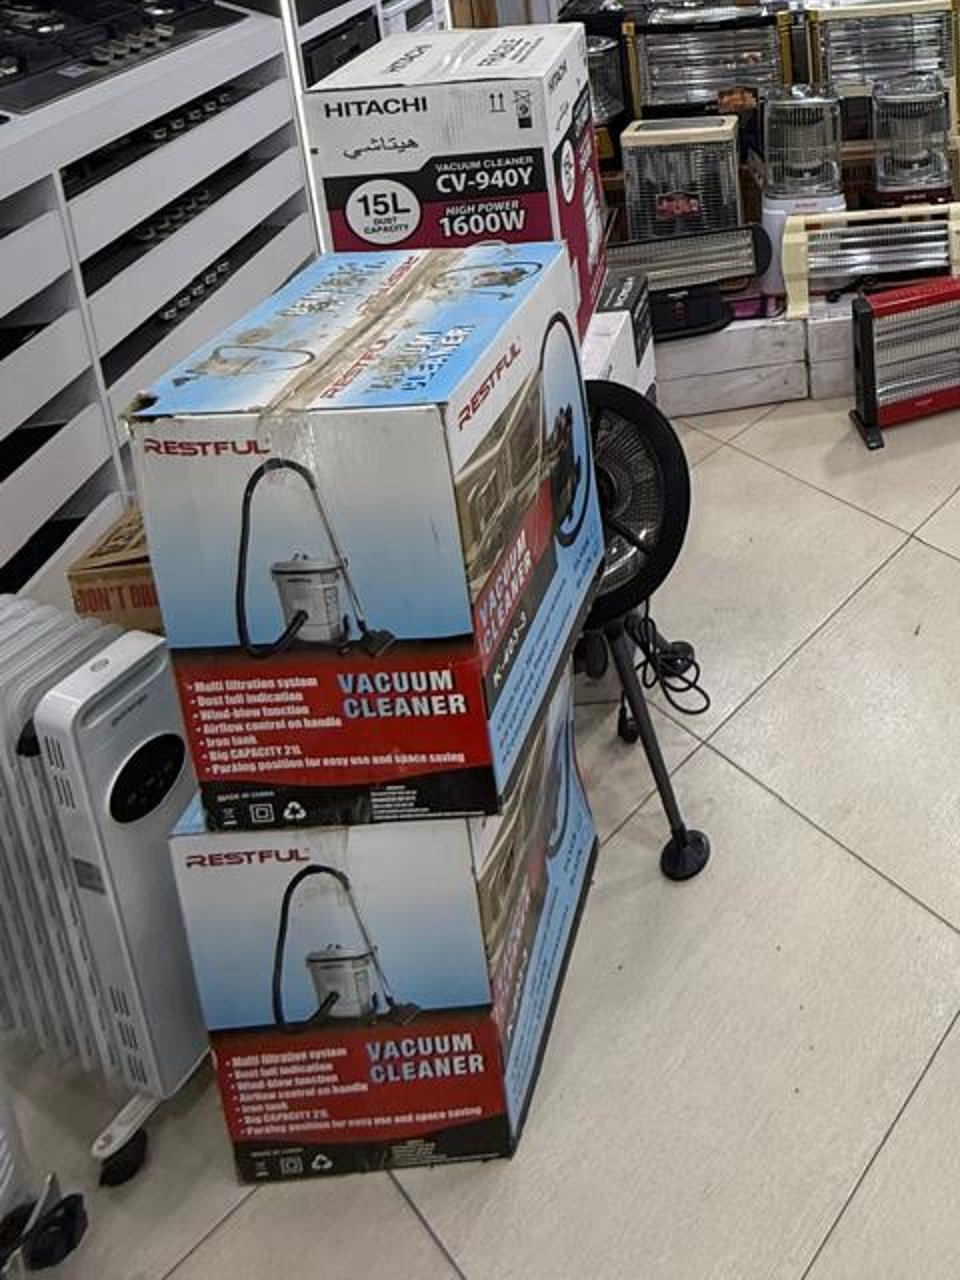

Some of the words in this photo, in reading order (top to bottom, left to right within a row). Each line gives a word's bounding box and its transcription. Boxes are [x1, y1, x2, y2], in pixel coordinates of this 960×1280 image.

[324, 95, 428, 119] HITACHI
[343, 135, 420, 160] هيتاشي
[435, 159, 481, 172] VACUUM
[484, 155, 534, 169] CLEANER
[435, 166, 534, 194] CV-940Y
[357, 191, 411, 217] 15L
[445, 205, 475, 217] HIGH
[477, 199, 520, 214] POWER
[363, 222, 410, 234] CAPACITY
[439, 209, 525, 237] 1600W
[458, 341, 521, 431] RESTFUL
[143, 437, 270, 457] RESTFUL
[337, 669, 453, 694] VACUUM
[343, 692, 467, 718] CLEANER
[230, 746, 282, 760] CAPACITY
[186, 848, 310, 869] RESTFUL
[366, 1032, 474, 1062] VACUUM
[369, 1054, 485, 1084] CLEANER
